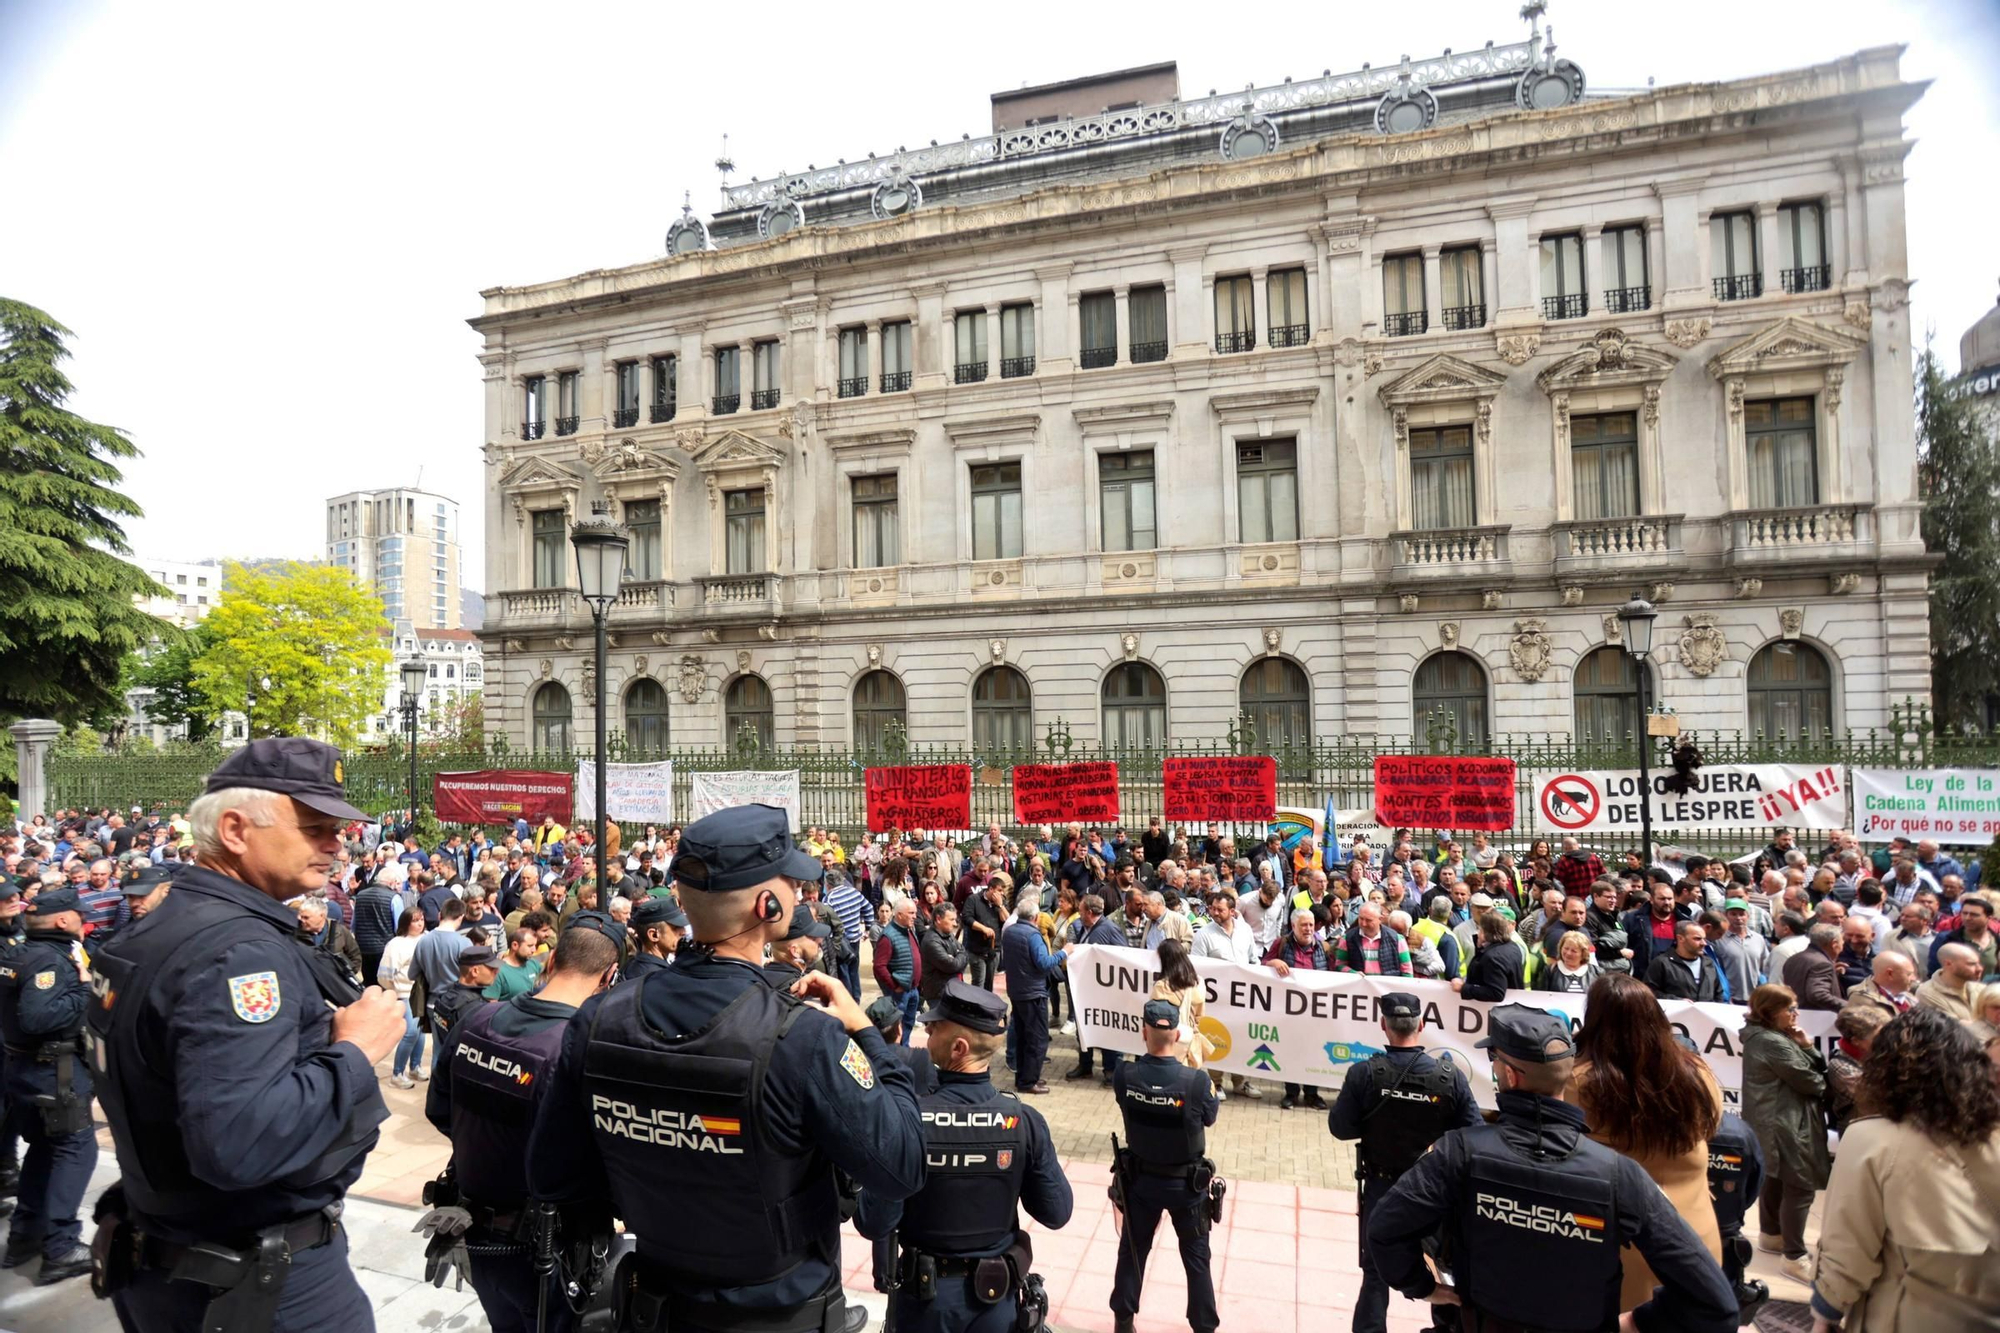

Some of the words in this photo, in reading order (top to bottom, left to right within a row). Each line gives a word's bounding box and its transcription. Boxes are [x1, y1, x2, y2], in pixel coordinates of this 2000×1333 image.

[1189, 760, 1218, 769] JUNTA
[1221, 760, 1267, 769] GENERAL
[870, 766, 966, 790] MINISTERIO
[1175, 772, 1187, 780] SE
[1190, 771, 1222, 780] LEGISLA
[1225, 769, 1259, 778] CONTRA
[1380, 775, 1452, 786] GANADEROS
[490, 783, 527, 792] NUESTROS
[528, 785, 567, 794] DERECHOS
[1170, 781, 1184, 790] EL
[1188, 779, 1225, 789] MUNDO
[1229, 778, 1265, 788] RURAL
[1696, 773, 1762, 794] UERA
[1906, 775, 1933, 793] Ley
[1946, 776, 1965, 791] de
[1977, 776, 1992, 791] la
[1019, 791, 1064, 805] ASTURIAS
[1065, 790, 1076, 800] ES
[1060, 800, 1074, 809] NO
[1383, 795, 1442, 809] MONTES
[1865, 795, 1926, 810] Cadena
[1024, 809, 1064, 822] RESERVA
[1073, 805, 1109, 818] LOBERA
[1166, 806, 1190, 816] CERO
[1193, 806, 1206, 815] AL
[1207, 803, 1273, 821] IZQUIERDO
[1382, 810, 1452, 823] NCENDIOS
[1661, 800, 1755, 822] LESPRE
[1901, 815, 1929, 834] qué
[1935, 820, 1953, 832] no
[1959, 821, 1977, 832] se
[1095, 962, 1218, 1003] UNIS
[1230, 980, 1272, 1012] EN
[1285, 988, 1444, 1030] DEFEA
[1248, 1023, 1280, 1042] UCA
[456, 1043, 521, 1079] POLICIA
[1126, 1089, 1176, 1106] POLICIA
[1381, 1088, 1431, 1103] POLICIA
[921, 1112, 1006, 1127] POLICIA
[594, 1113, 744, 1154] NACIONAL
[926, 1153, 987, 1167] UIP
[1477, 1192, 1577, 1225] POLICIA
[1477, 1204, 1604, 1243] NACIONAL
